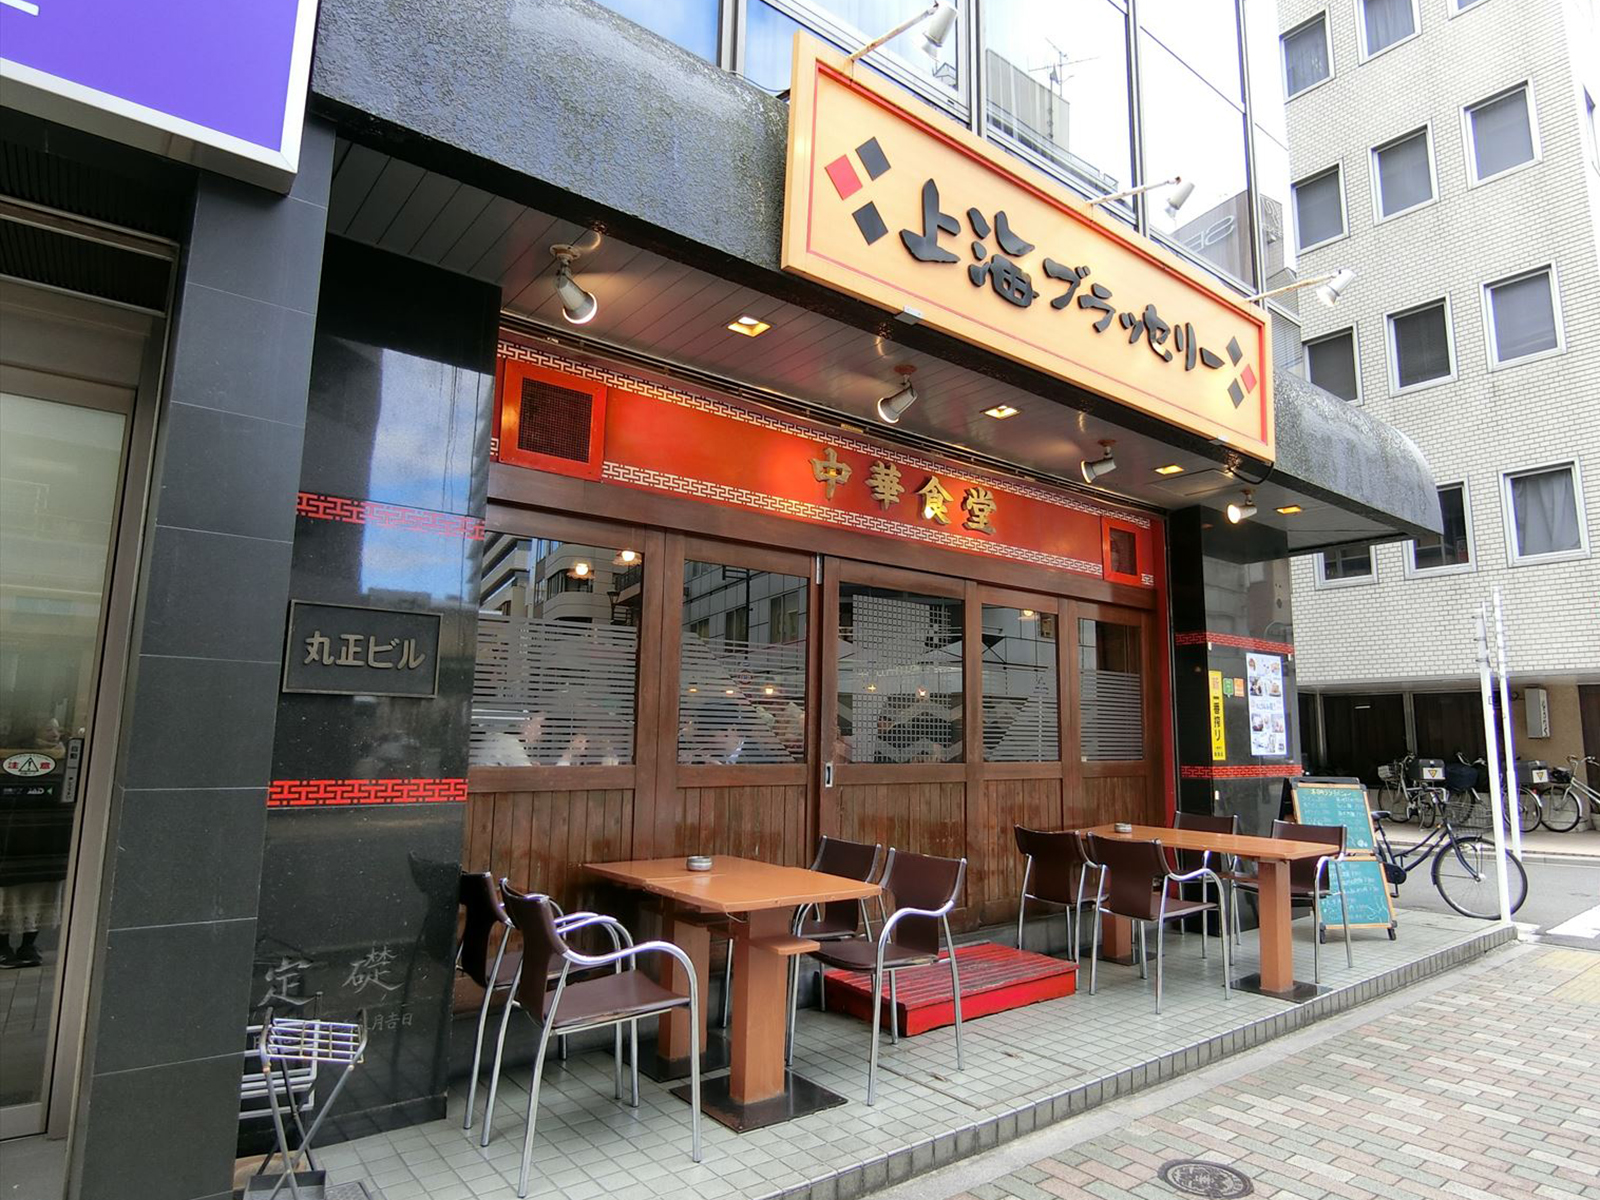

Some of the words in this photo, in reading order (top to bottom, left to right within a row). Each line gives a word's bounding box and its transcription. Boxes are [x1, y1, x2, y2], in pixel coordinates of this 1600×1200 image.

[899, 178, 1225, 371] 上海ブラッセリー
[808, 446, 997, 535] 中華食堂
[303, 630, 426, 670] 丸正ビル
[257, 942, 404, 1006] 定礎
